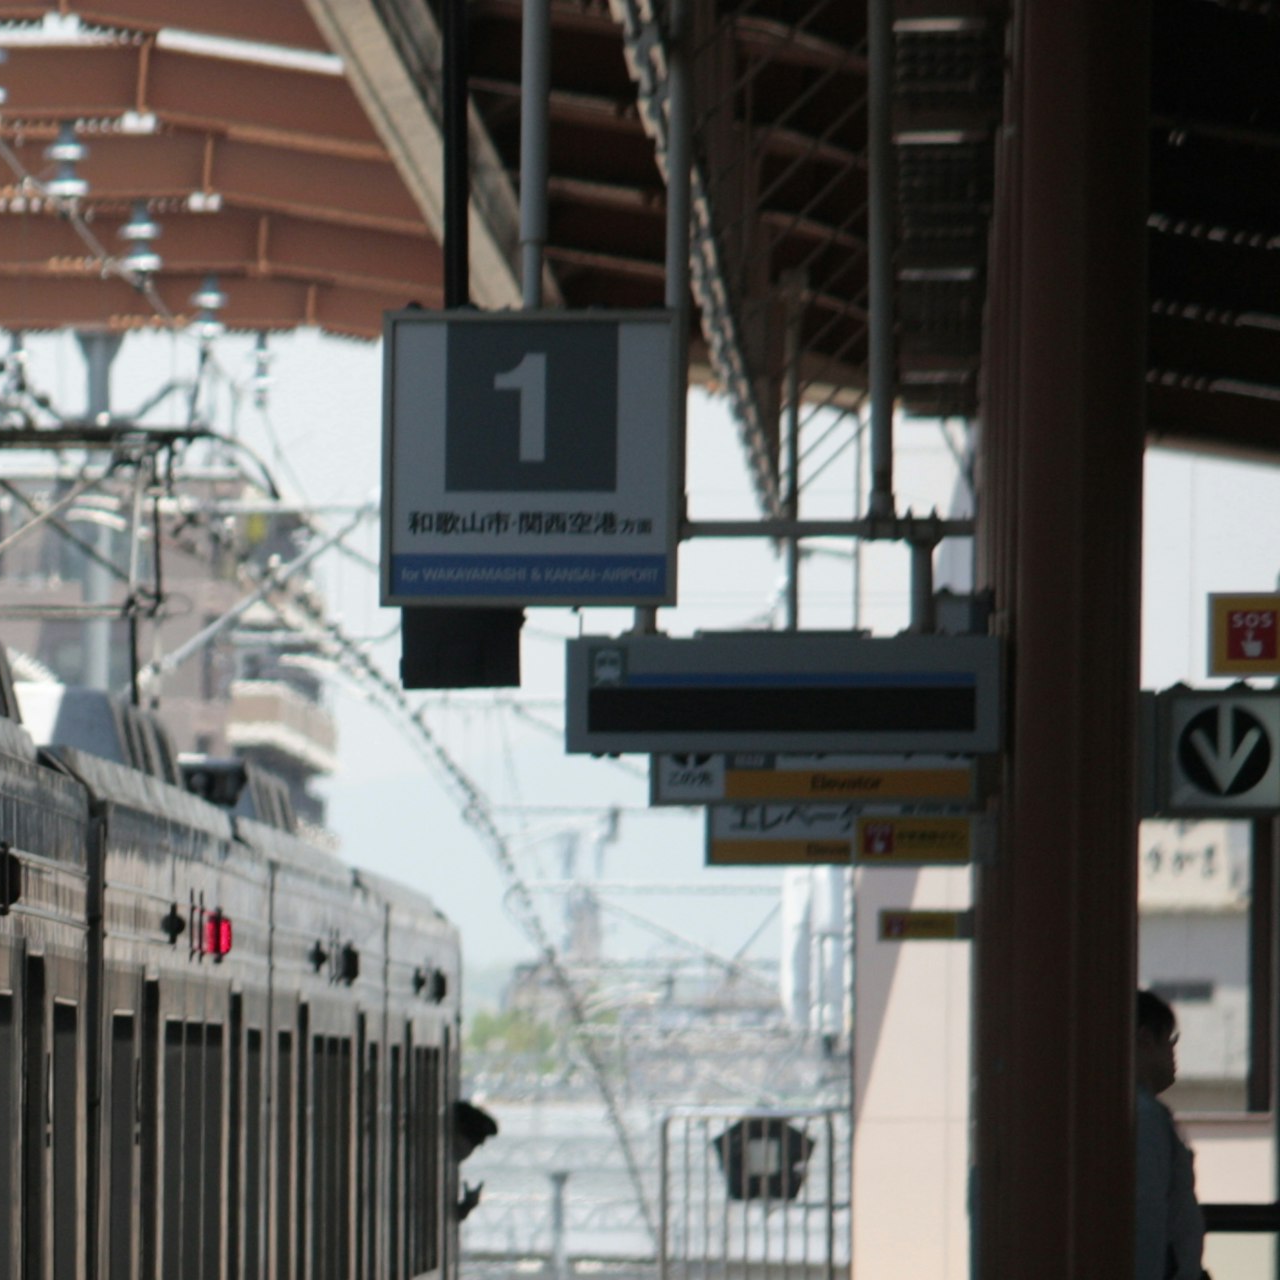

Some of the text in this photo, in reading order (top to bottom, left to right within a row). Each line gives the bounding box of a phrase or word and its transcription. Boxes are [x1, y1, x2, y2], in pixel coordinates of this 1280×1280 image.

[493, 350, 547, 464] 1
[422, 567, 526, 582] WAKAYAMASHI
[545, 567, 658, 582] KANSAI-AIRPORT
[1231, 612, 1273, 628] SOS
[810, 774, 882, 791] Elevator
